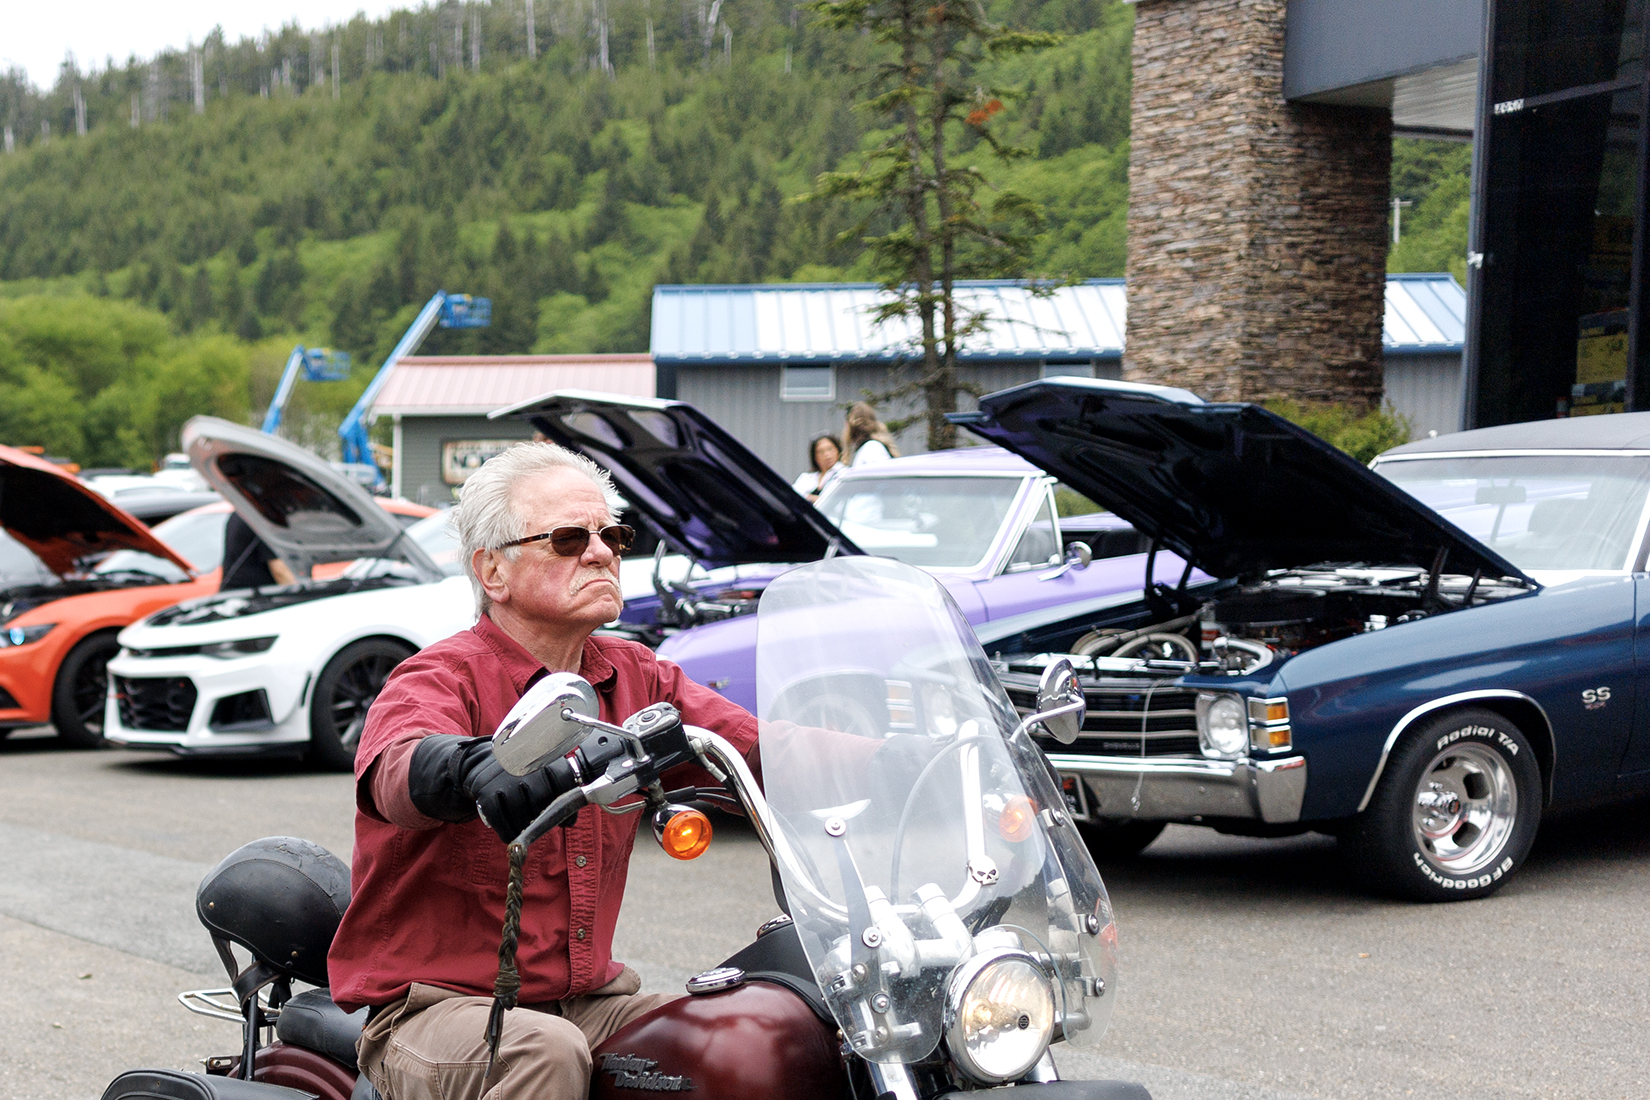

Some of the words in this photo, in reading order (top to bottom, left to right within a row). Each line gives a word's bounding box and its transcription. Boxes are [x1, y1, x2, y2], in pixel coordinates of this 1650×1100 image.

[1581, 686, 1611, 704] SS
[1437, 725, 1495, 750] Radial
[1497, 732, 1520, 757] T/A
[1413, 852, 1514, 889] BFGoodrich
